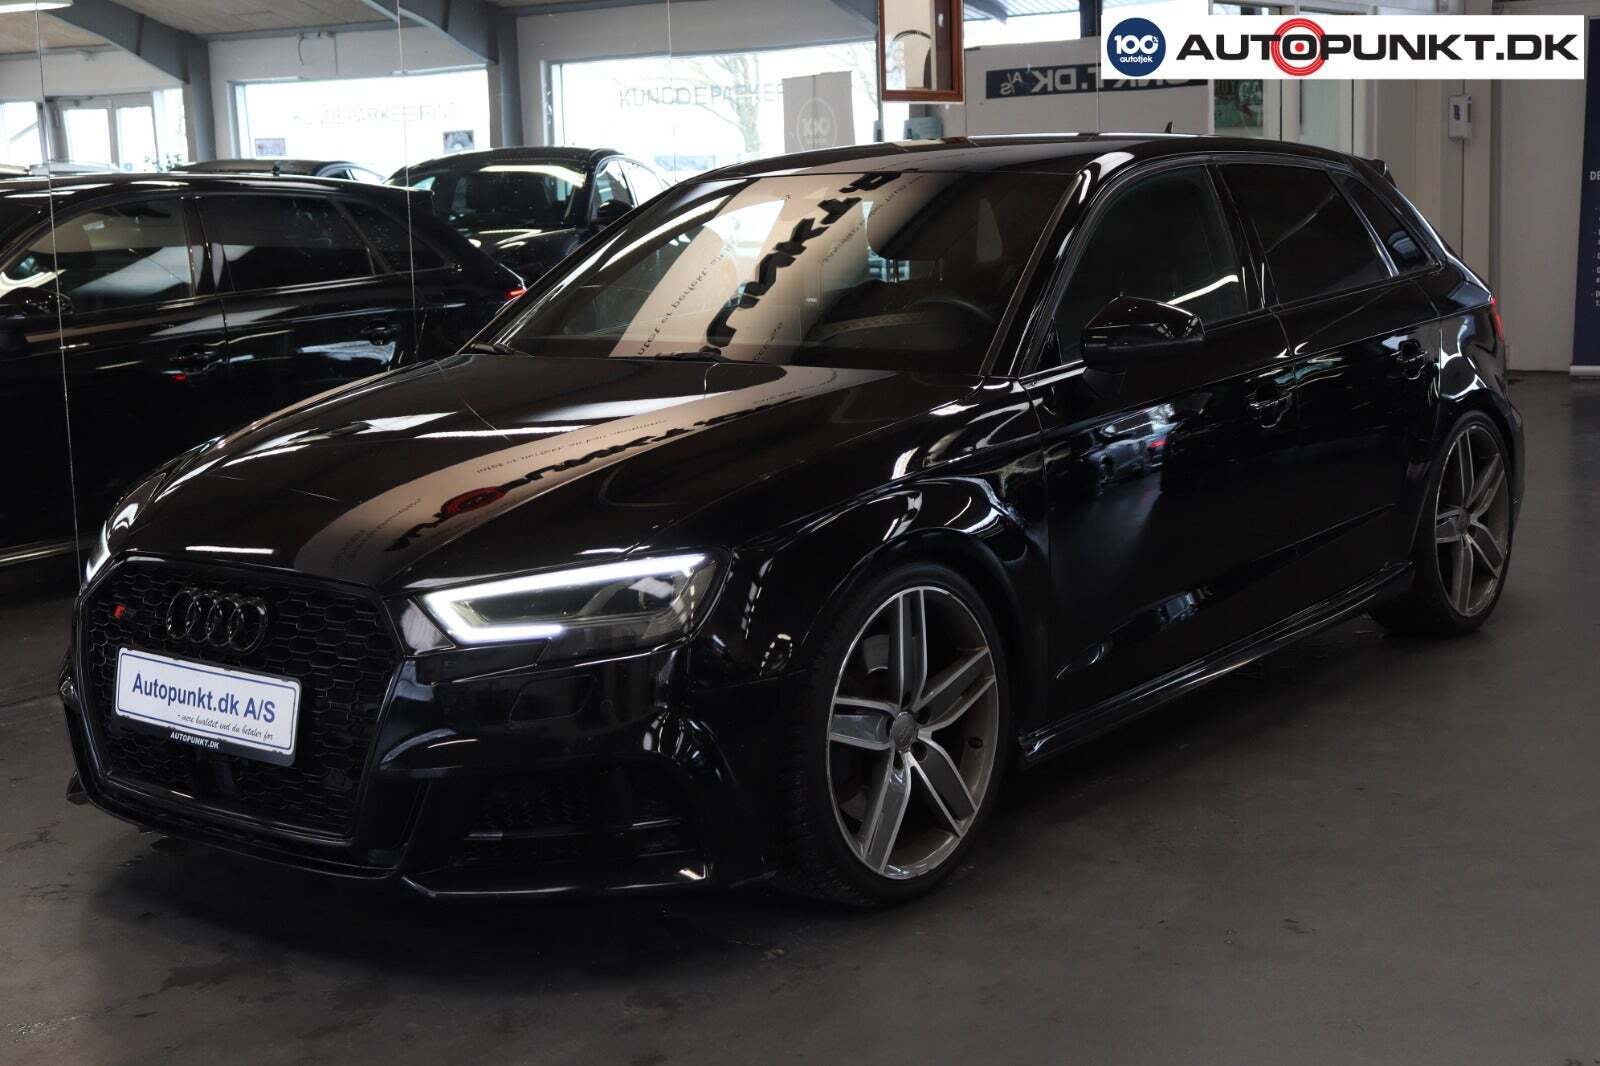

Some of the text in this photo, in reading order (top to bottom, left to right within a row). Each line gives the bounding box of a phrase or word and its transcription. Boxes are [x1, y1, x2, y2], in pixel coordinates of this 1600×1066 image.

[132, 673, 276, 724] Autopunkt.dk A/S
[170, 731, 220, 750] AUTOPUNKT.DK
